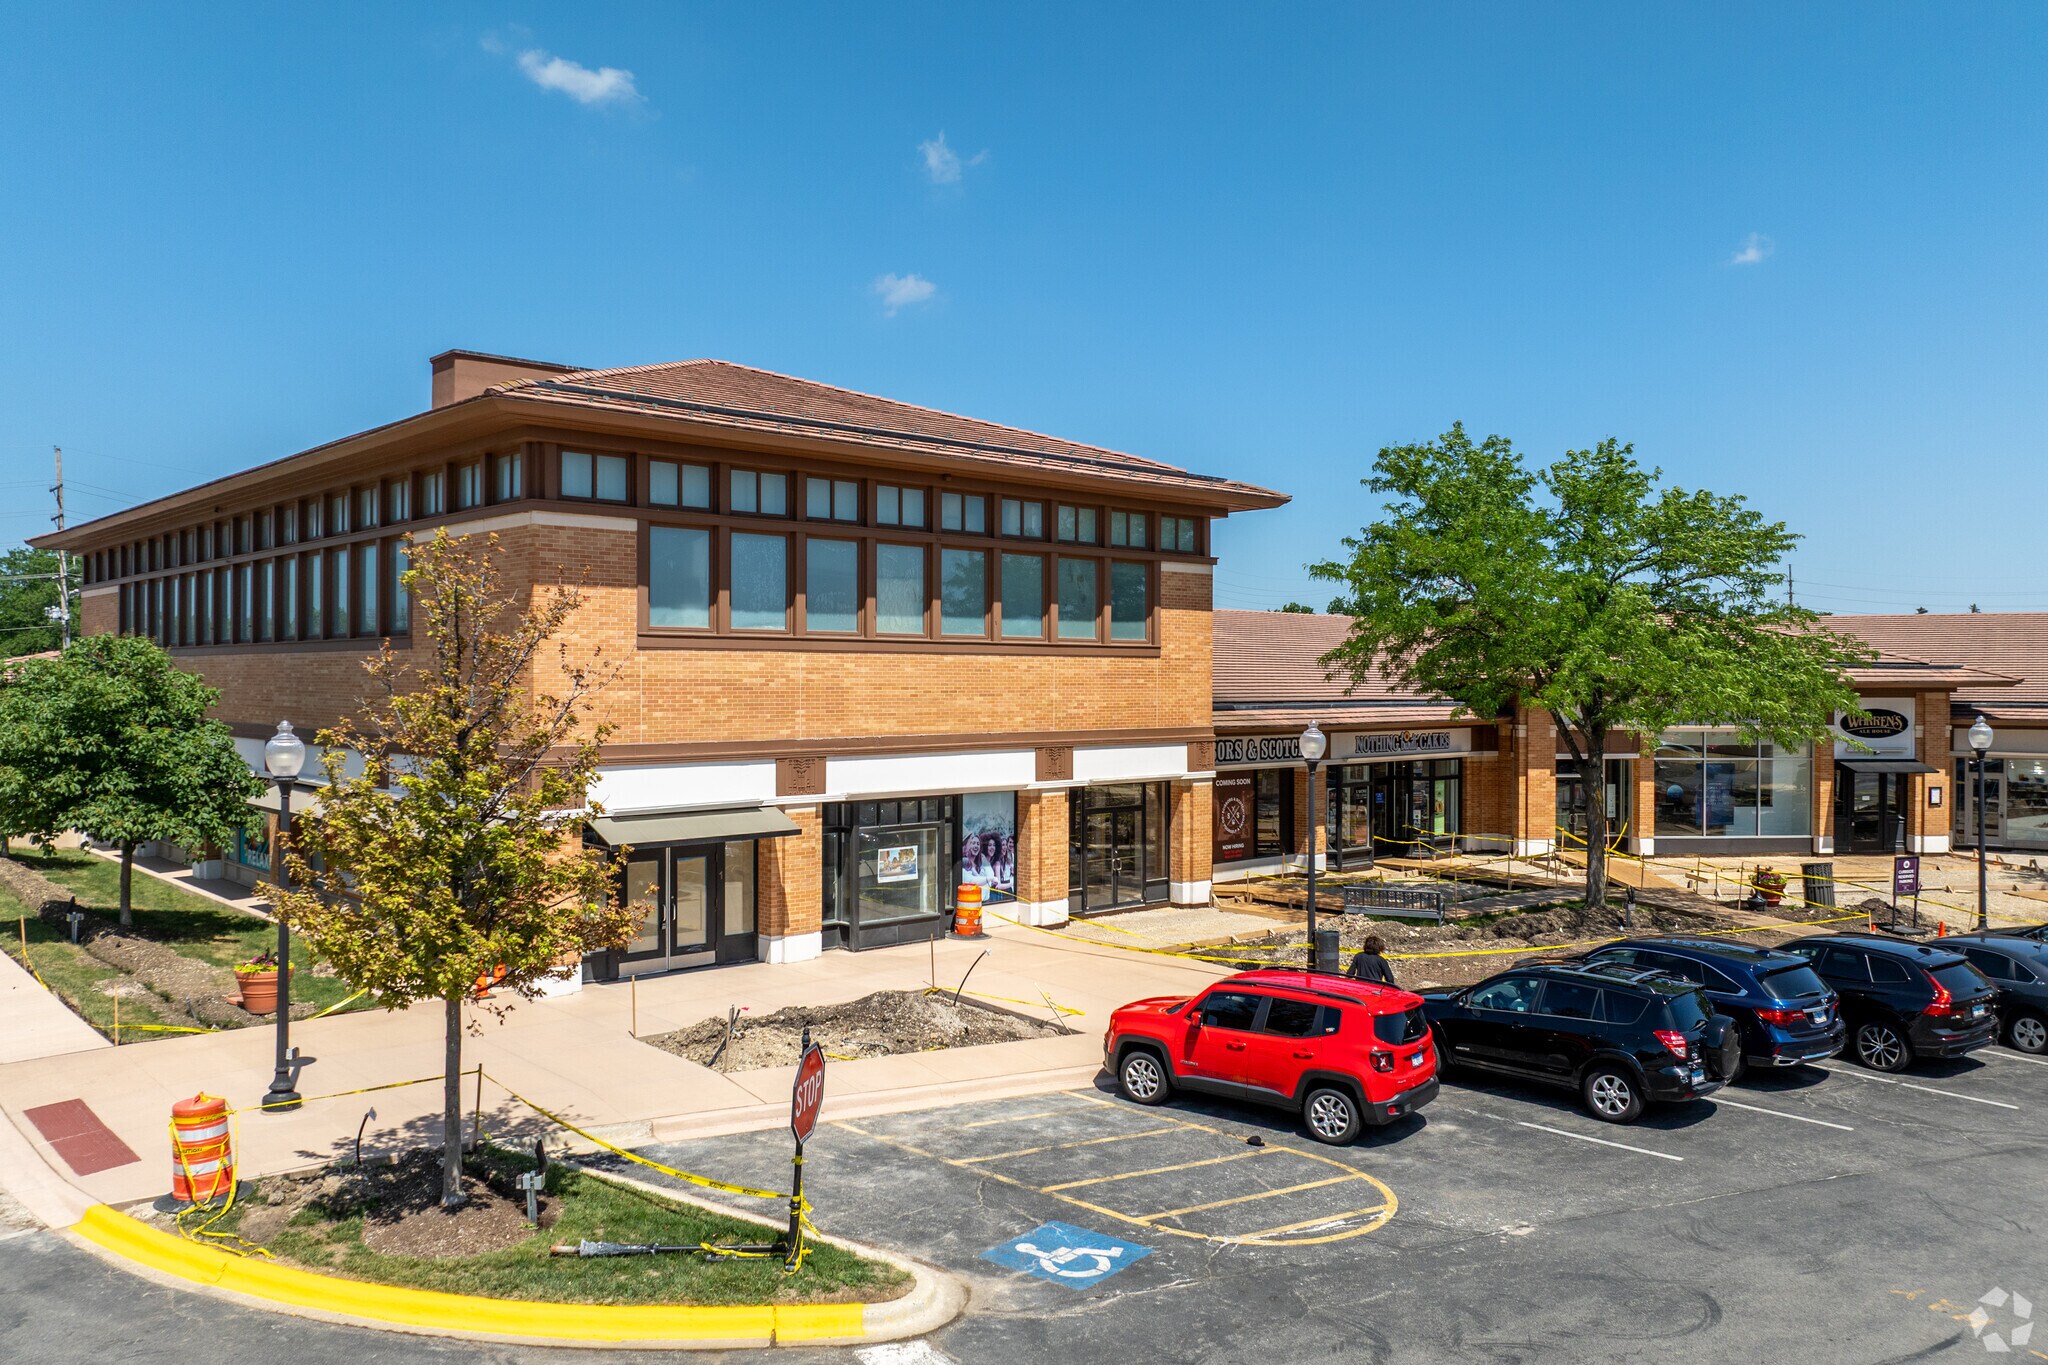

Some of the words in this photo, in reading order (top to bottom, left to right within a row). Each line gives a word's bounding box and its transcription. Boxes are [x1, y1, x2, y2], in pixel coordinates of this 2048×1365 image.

[1246, 739, 1257, 761] &
[1355, 734, 1399, 754] NOTHING
[1420, 732, 1450, 750] CAKES
[796, 1070, 821, 1118] STOP
